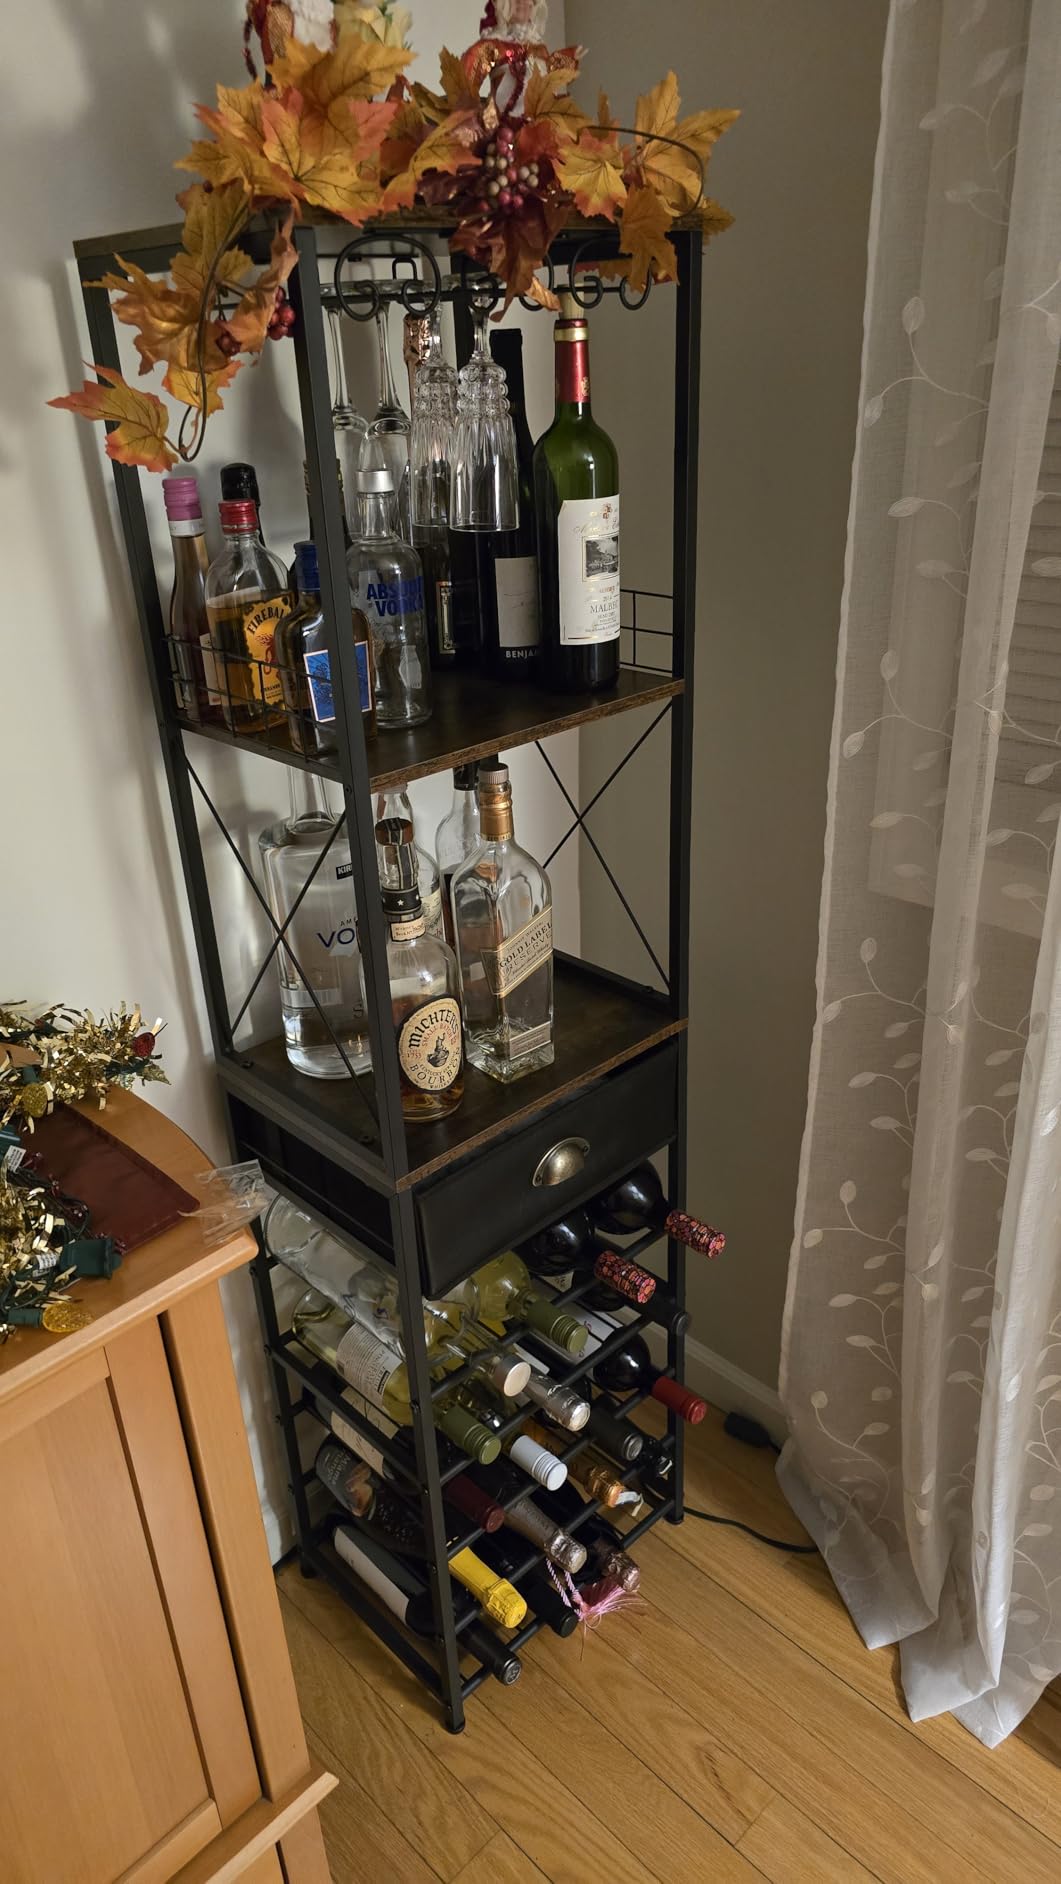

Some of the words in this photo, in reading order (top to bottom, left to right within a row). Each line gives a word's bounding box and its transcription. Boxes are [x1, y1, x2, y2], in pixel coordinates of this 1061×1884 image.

[246, 606, 285, 635] FIREBAL
[337, 863, 353, 875] KIR
[316, 927, 356, 948] VO
[499, 945, 524, 968] GOLD
[524, 922, 552, 947] LABEL
